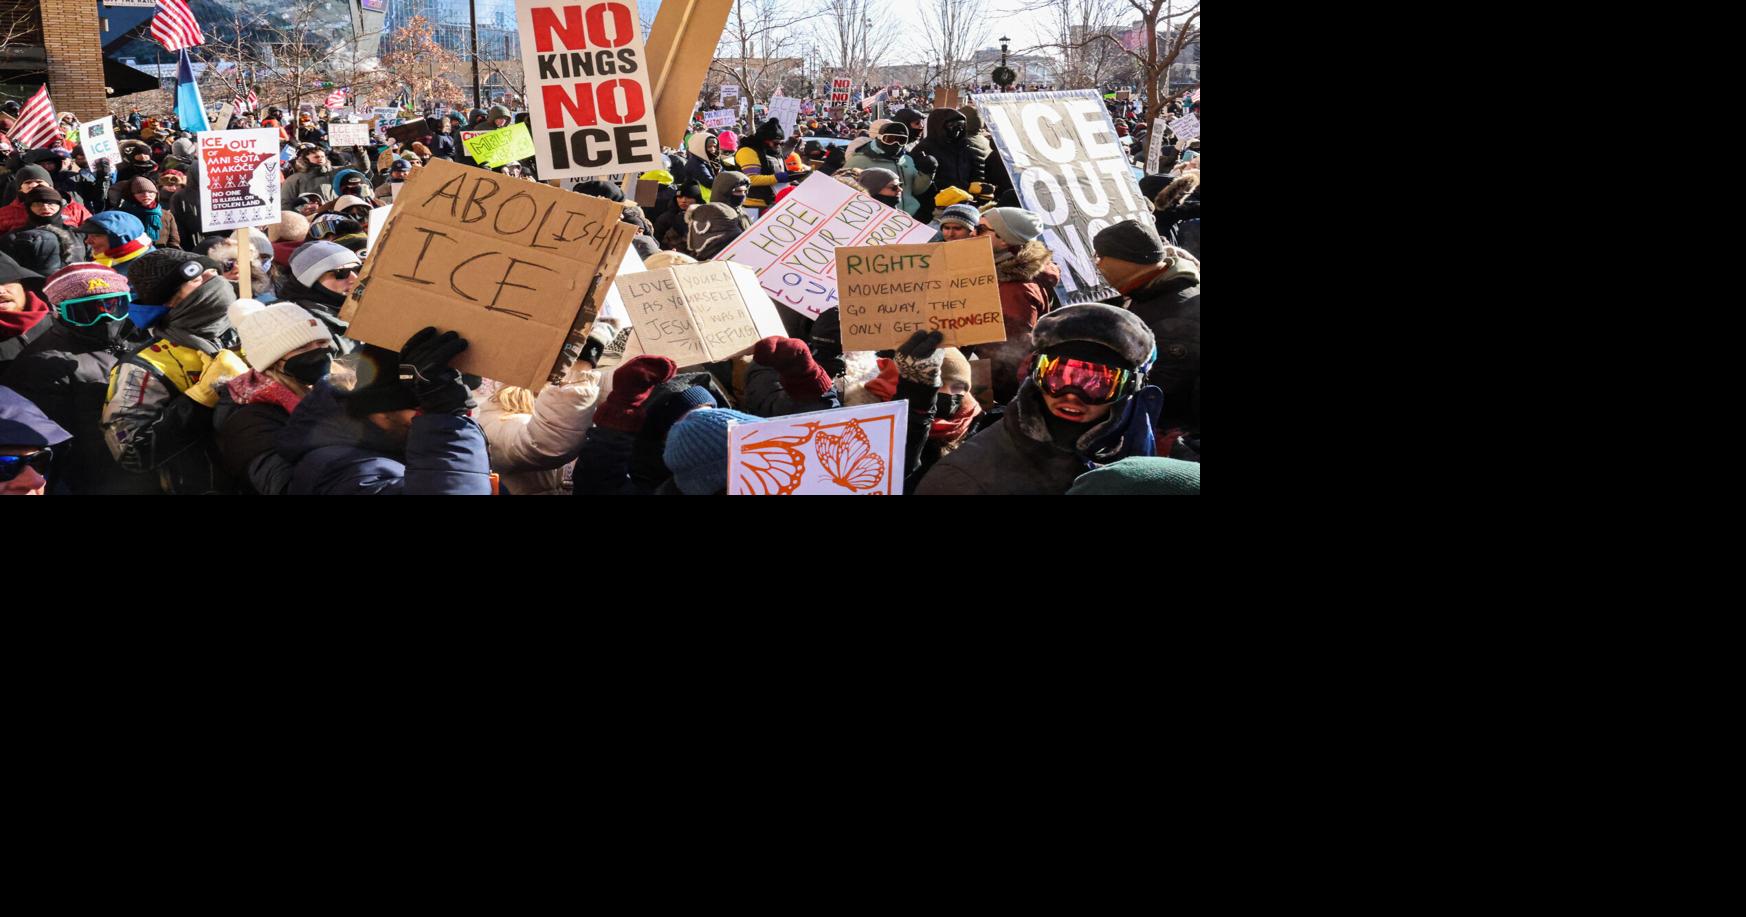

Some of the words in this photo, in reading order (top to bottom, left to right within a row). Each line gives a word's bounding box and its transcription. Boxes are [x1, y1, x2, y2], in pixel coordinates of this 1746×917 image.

[531, 2, 634, 53] NO
[537, 48, 638, 80] KINGS
[833, 79, 850, 88] NO
[543, 78, 646, 129] NO
[832, 93, 849, 102] NO
[202, 138, 223, 147] ICE
[230, 139, 256, 149] OUT
[470, 129, 513, 155] MELT
[988, 100, 1119, 166] ICE
[91, 140, 111, 154] ICE
[549, 125, 653, 170] ICE
[1020, 158, 1138, 226] OUT
[751, 202, 819, 257] HOPE
[786, 229, 850, 275] YOUR
[836, 194, 882, 231] KIDS
[393, 226, 559, 320] ICE
[847, 254, 932, 275] RIGHTS
[628, 278, 676, 299] LOVE
[848, 280, 944, 297] MOVEMENTS
[950, 275, 995, 289] NEVER
[643, 301, 664, 315] AS
[847, 304, 866, 317] GO
[877, 301, 920, 315] AWAY,
[928, 299, 967, 310] THEY
[645, 318, 692, 341] JESU
[849, 323, 882, 336] ONLY
[893, 321, 924, 333] GET
[928, 311, 1000, 331] STRONGER
